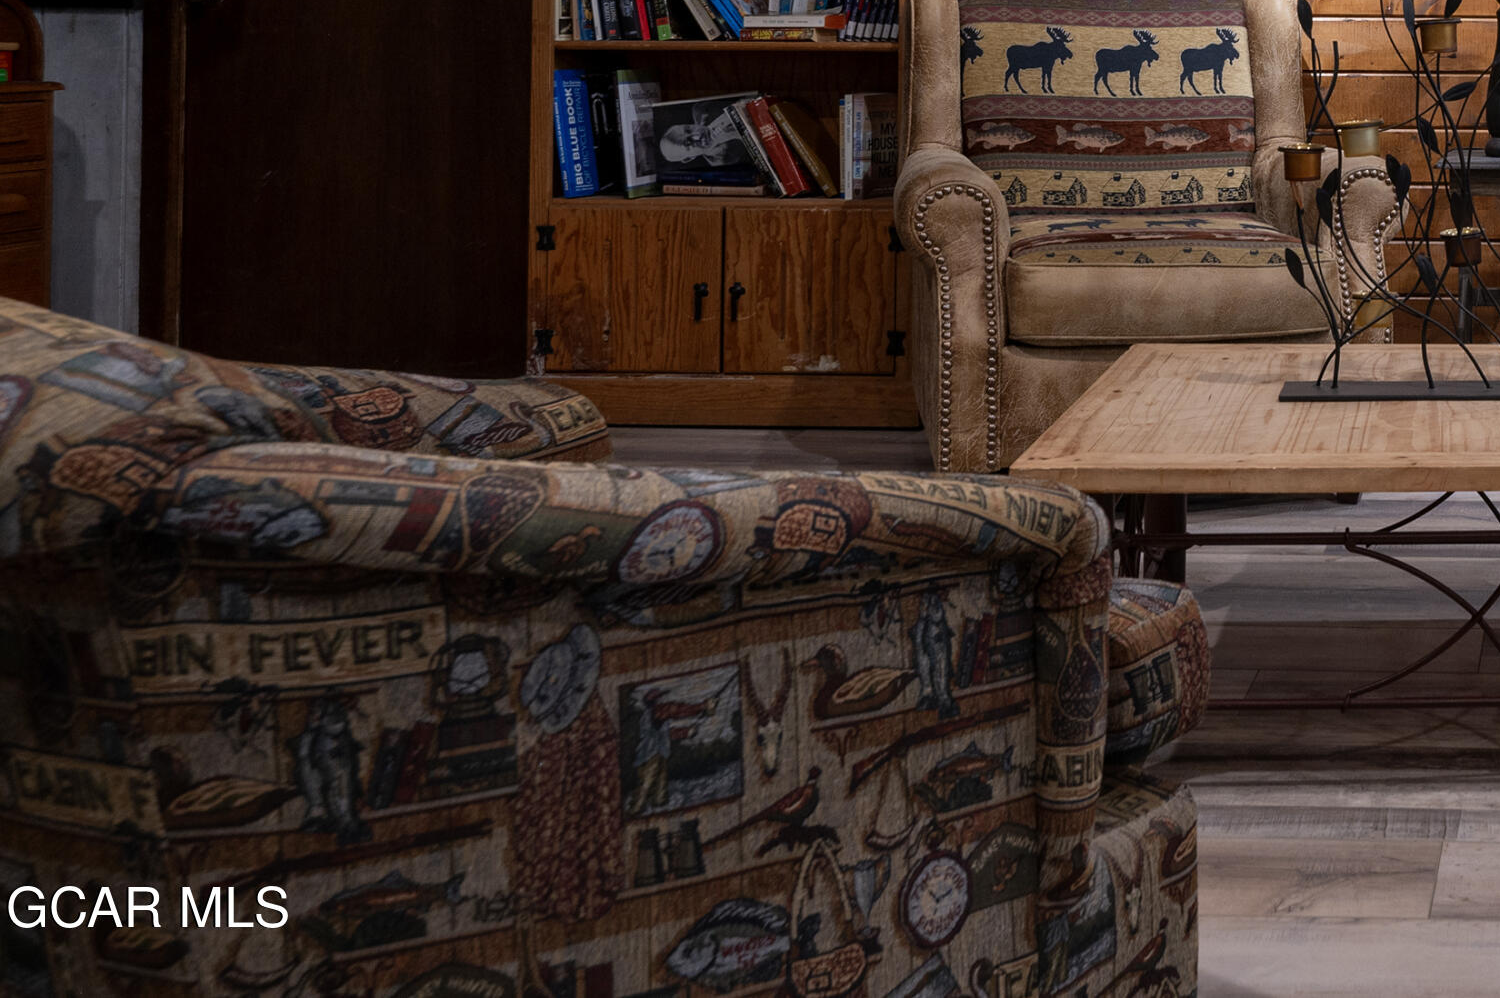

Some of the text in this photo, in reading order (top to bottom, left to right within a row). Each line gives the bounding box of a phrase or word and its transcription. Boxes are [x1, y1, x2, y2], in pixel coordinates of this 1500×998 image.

[573, 86, 584, 122] REPAIR
[563, 87, 584, 185] BIG BLUE BOOK
[577, 124, 590, 166] BICYCLE
[873, 477, 989, 512] FEVER
[248, 620, 429, 673] FEVER
